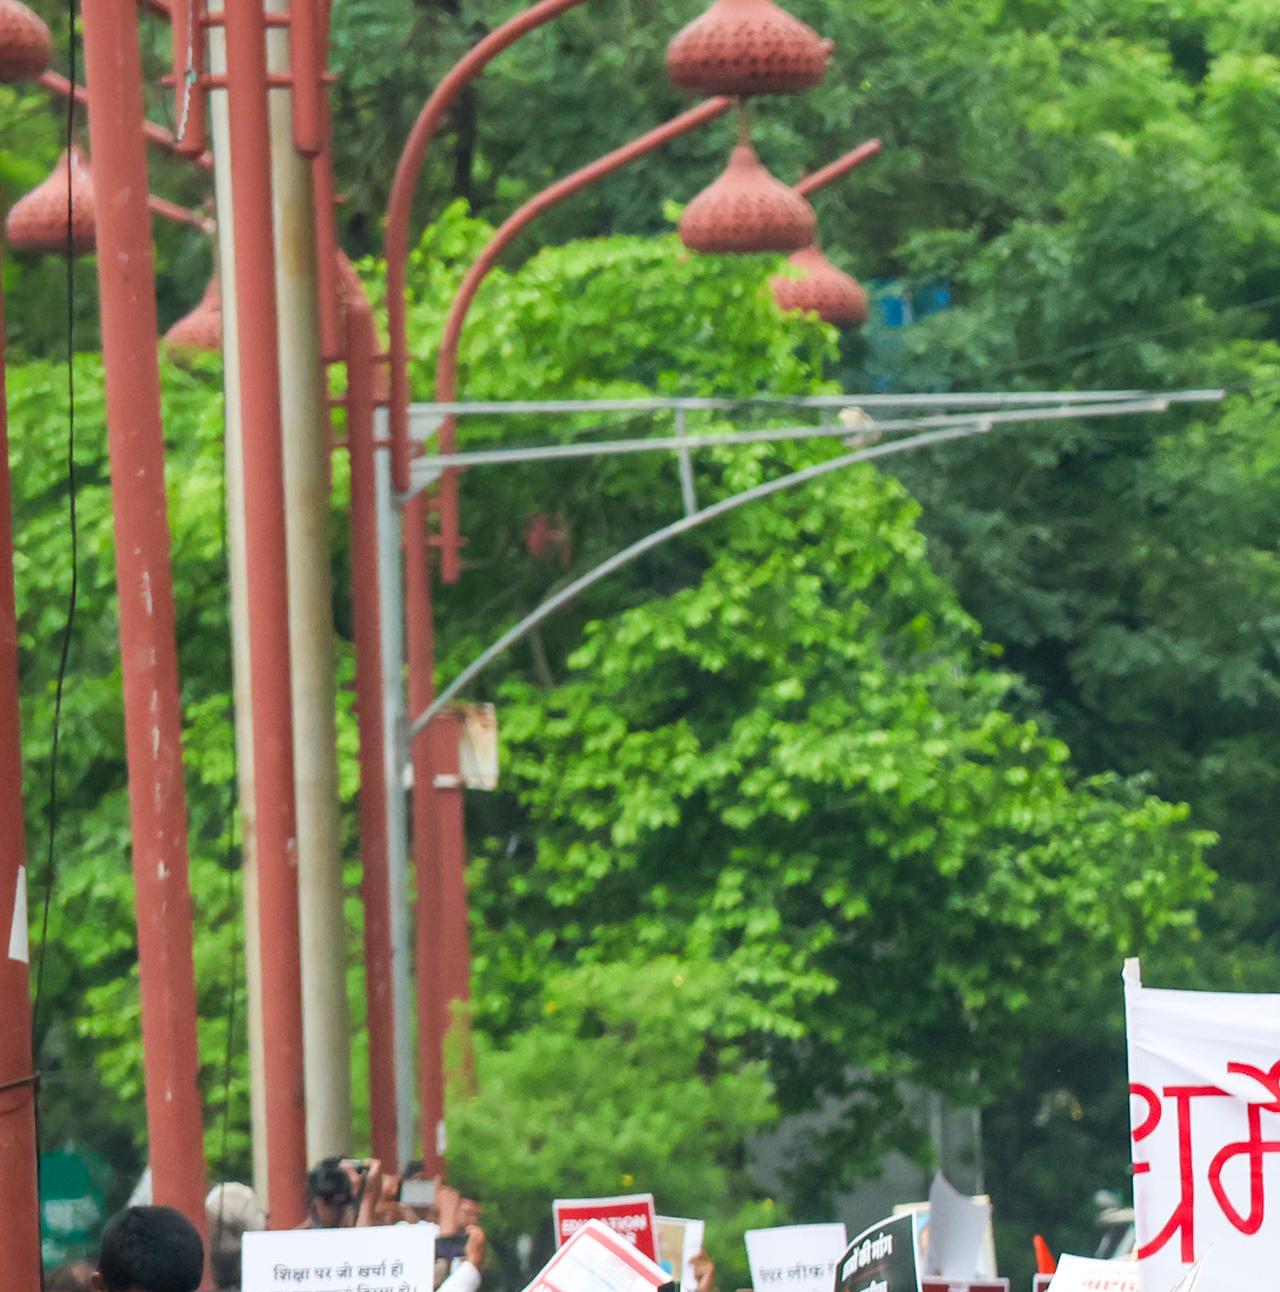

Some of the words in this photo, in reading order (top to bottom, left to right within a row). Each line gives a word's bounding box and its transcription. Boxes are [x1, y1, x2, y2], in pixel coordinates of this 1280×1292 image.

[273, 1262, 309, 1282] शिक्षा
[314, 1266, 331, 1280] पर
[336, 1261, 352, 1279] जो
[391, 1258, 404, 1278] हो
